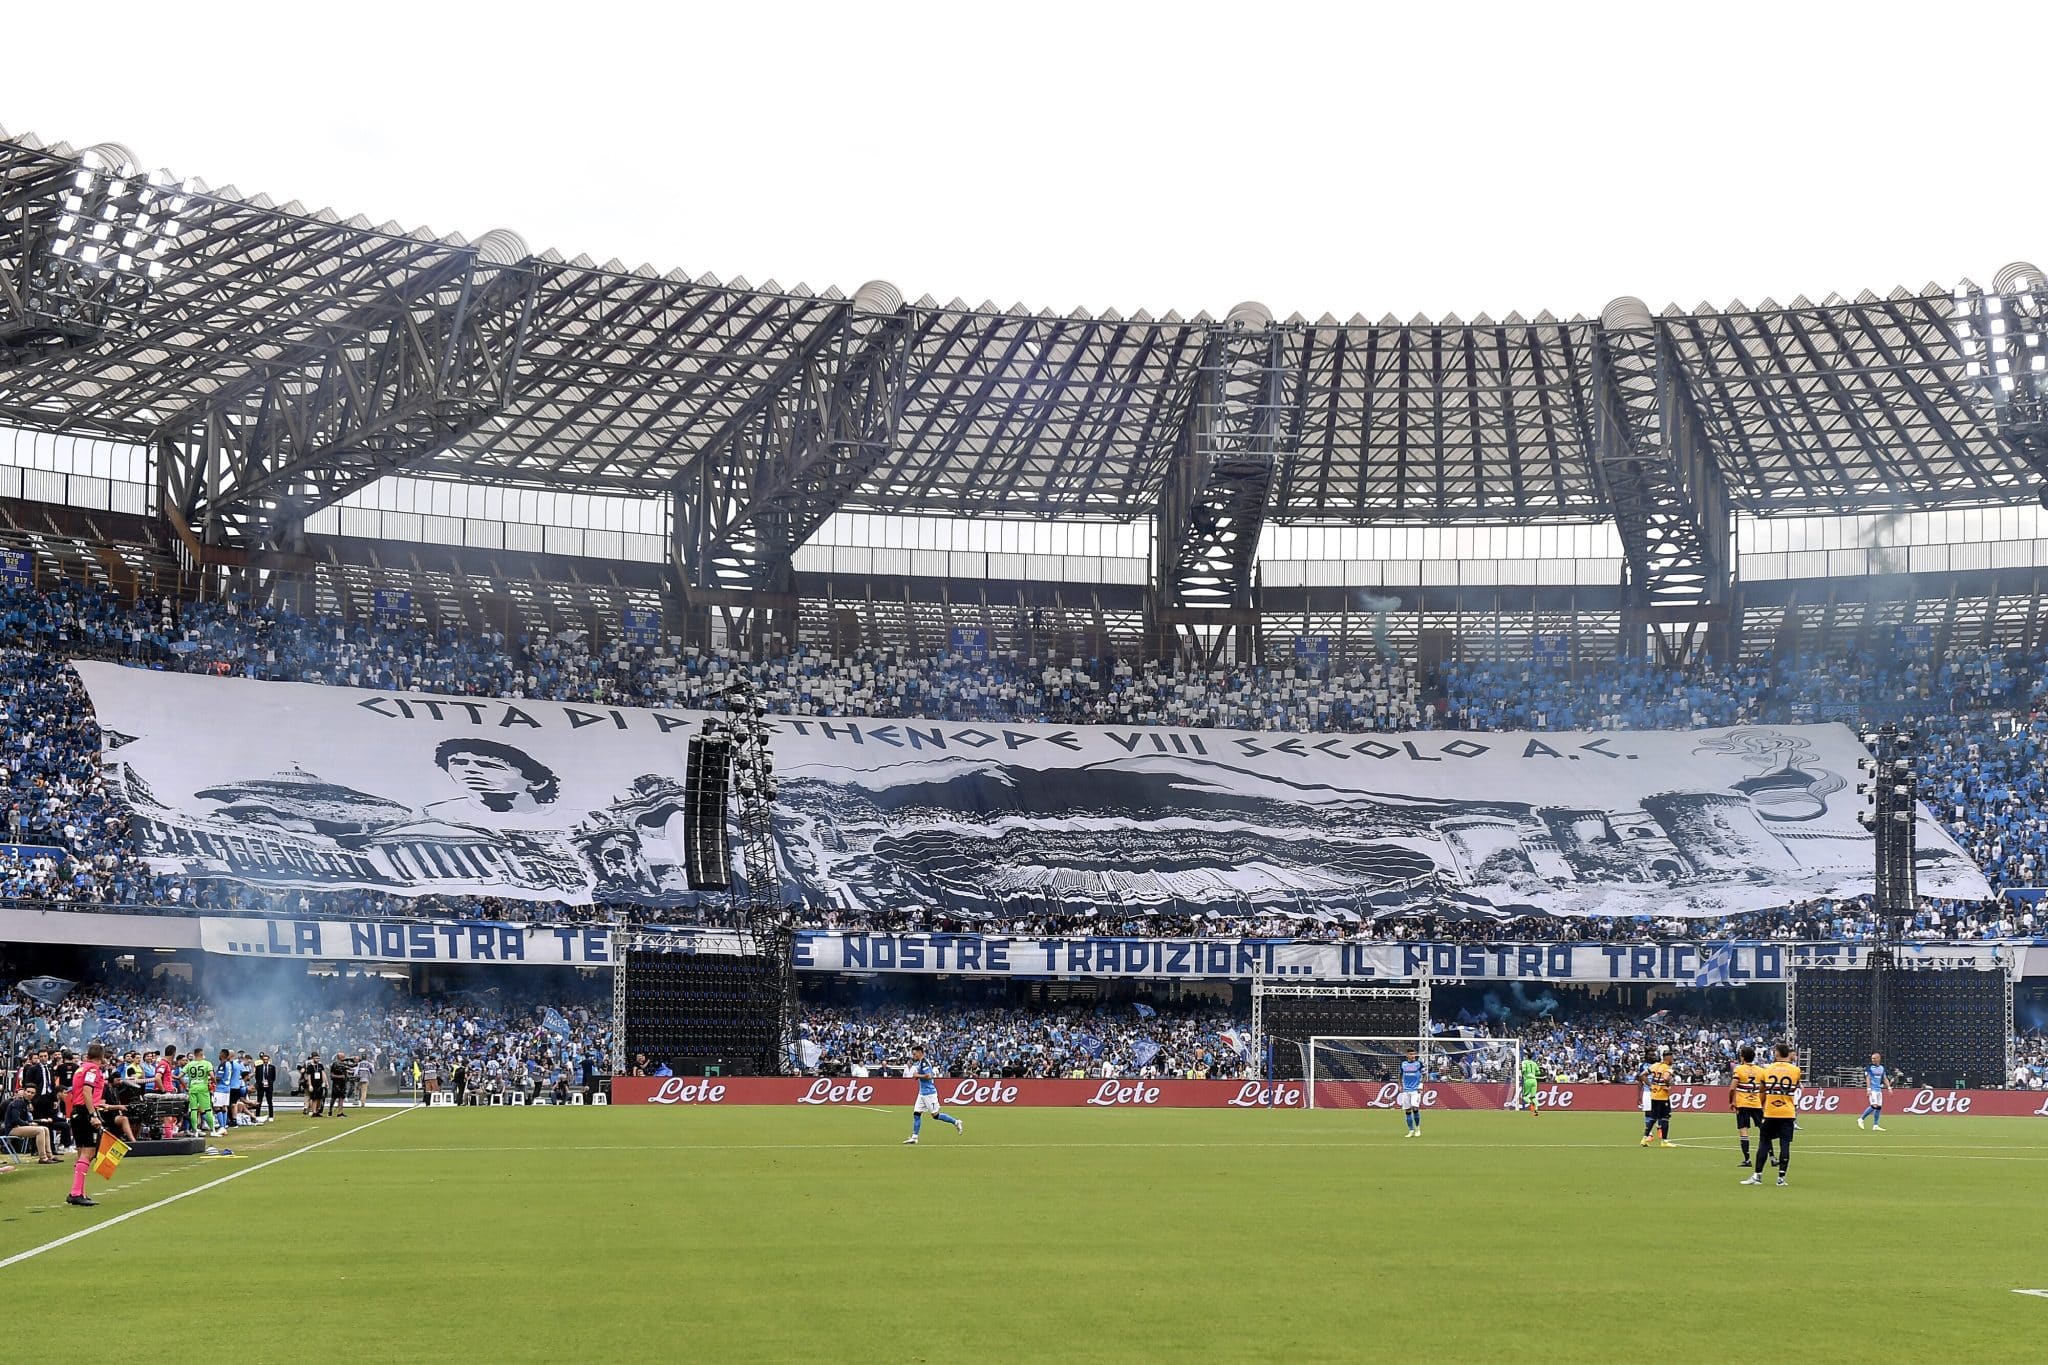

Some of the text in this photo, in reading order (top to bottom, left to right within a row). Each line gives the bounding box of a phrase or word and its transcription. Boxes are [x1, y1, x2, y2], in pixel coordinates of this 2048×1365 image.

[357, 696, 543, 729] CITTÀ
[563, 707, 629, 730] DI
[1104, 731, 1209, 756] VIII
[1231, 737, 1491, 762] SECOLO
[350, 923, 525, 961] NOSTRA
[842, 934, 1011, 971] NOSTRE
[1341, 943, 1375, 976] IL
[1403, 944, 1572, 978] NOSTRO
[189, 1066, 205, 1078] 95
[1748, 1076, 1756, 1092] 3
[648, 1077, 726, 1104] Lete
[797, 1077, 874, 1104] Lete
[943, 1078, 1018, 1105] Lete
[1086, 1079, 1160, 1106] Lete
[1227, 1080, 1300, 1107] Lete
[1796, 1089, 1840, 1112] ete
[1903, 1089, 1971, 1114] Lete
